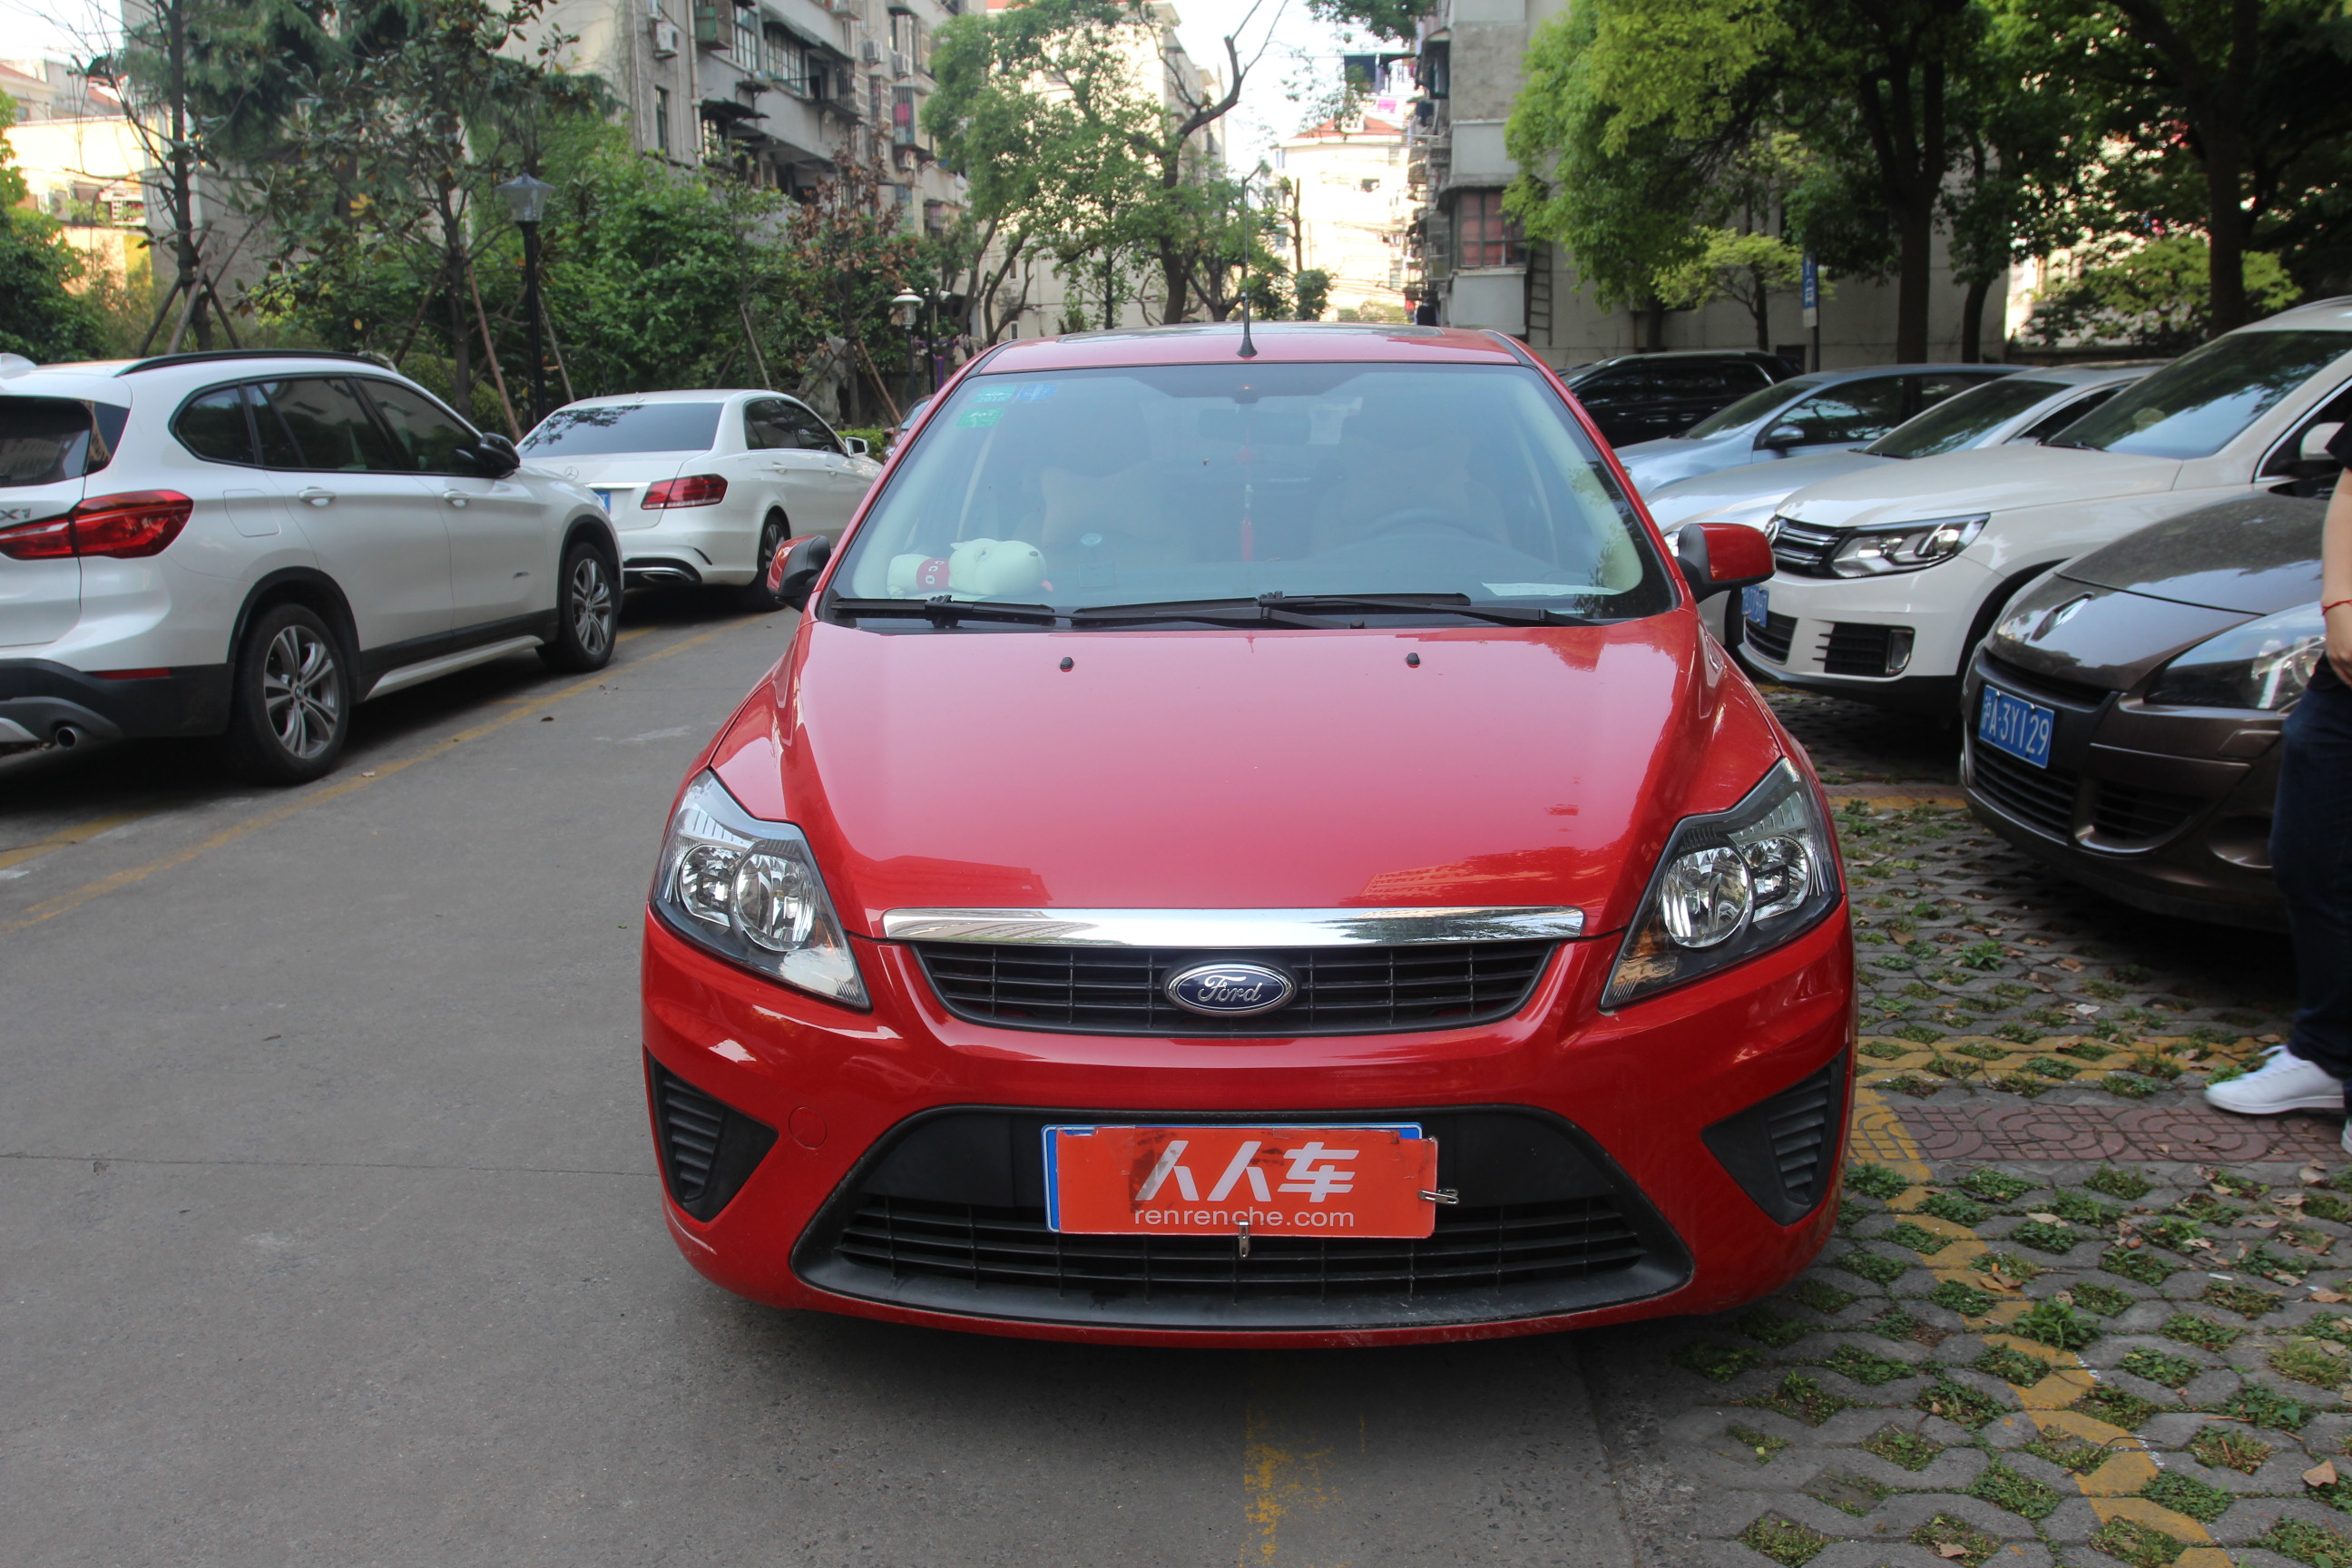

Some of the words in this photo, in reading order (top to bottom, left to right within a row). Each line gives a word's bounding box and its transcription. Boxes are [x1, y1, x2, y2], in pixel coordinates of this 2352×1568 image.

[1197, 975, 1264, 1003] Ford
[1134, 1140, 1361, 1204] 人人车
[1133, 1205, 1355, 1228] renrenche.com
